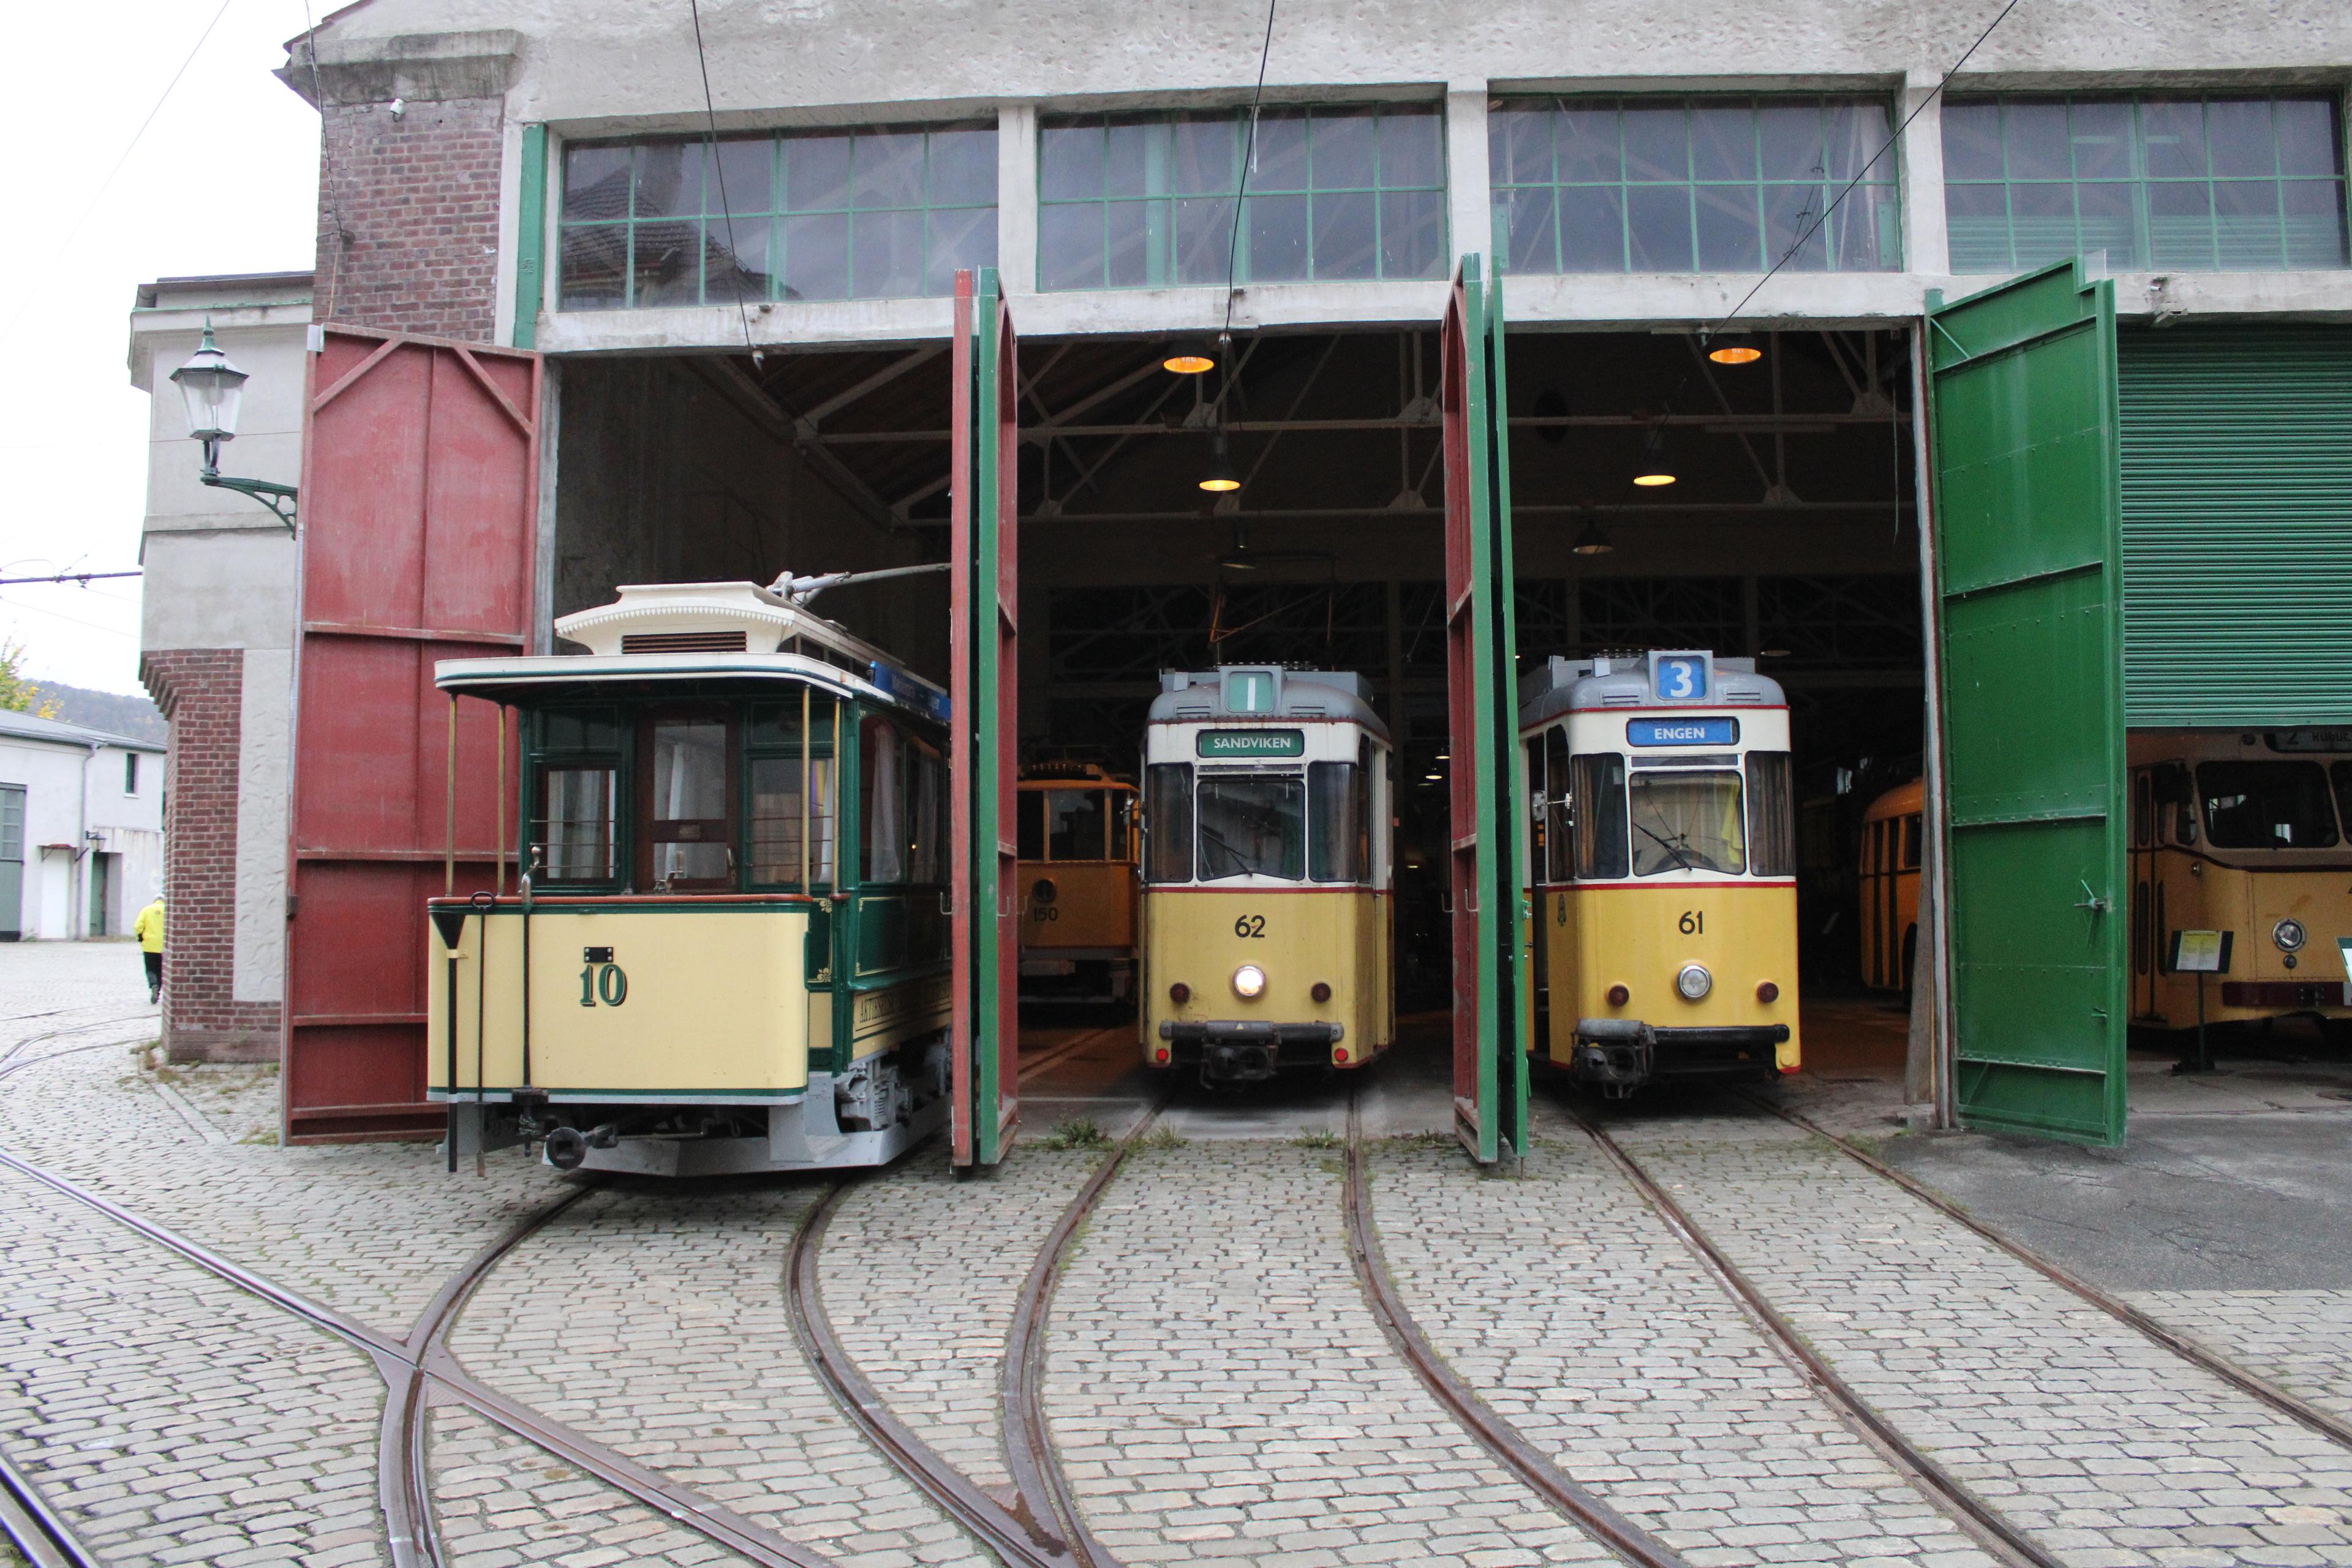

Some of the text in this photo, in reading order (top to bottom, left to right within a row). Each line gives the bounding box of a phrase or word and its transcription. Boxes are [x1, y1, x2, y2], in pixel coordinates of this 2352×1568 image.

[1670, 661, 1693, 698] 3
[1247, 677, 1256, 711] 1
[1214, 737, 1291, 748] SANDVIKEN
[1654, 727, 1705, 739] ENGEN
[1033, 907, 1058, 921] 150
[1679, 911, 1703, 934] 61
[1235, 914, 1265, 938] 62
[579, 963, 627, 1007] 10
